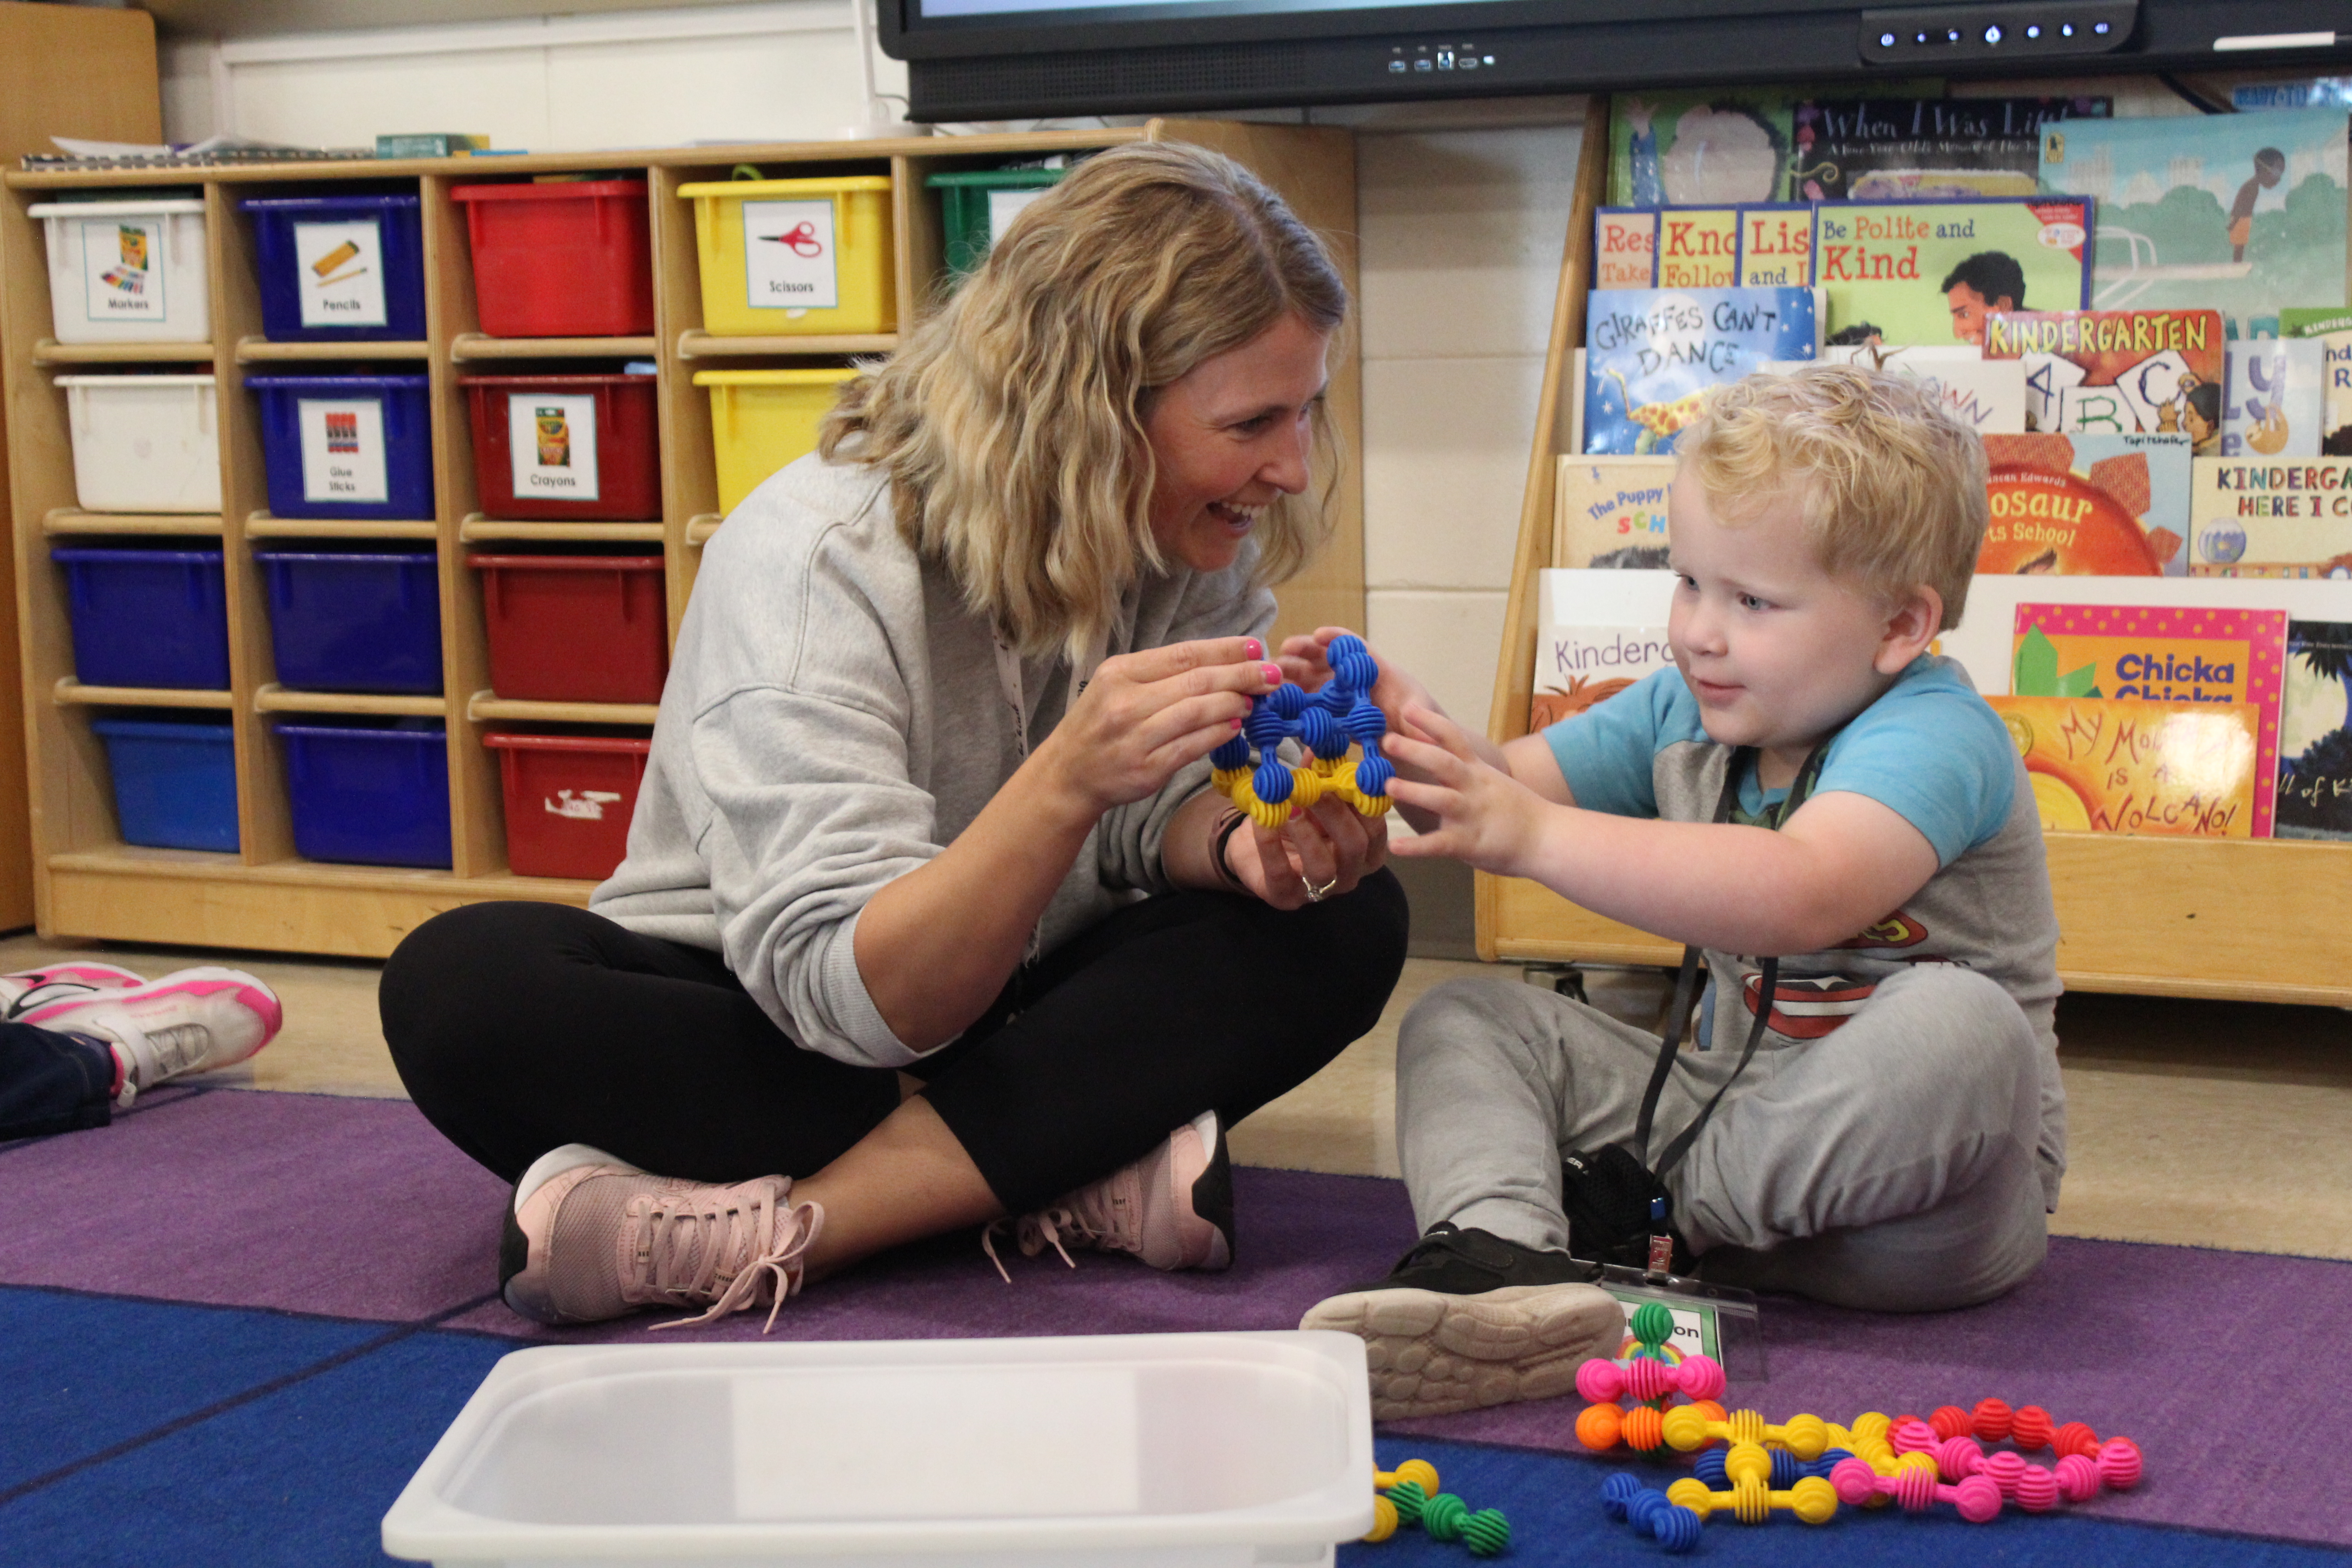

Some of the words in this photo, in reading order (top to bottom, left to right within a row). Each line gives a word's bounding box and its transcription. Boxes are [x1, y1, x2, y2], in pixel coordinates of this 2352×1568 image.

[1824, 102, 1896, 137] When
[1911, 101, 1922, 135] I
[1935, 106, 1987, 136] Was
[1750, 220, 1810, 255] Lis
[1823, 220, 1847, 240] Be
[1854, 215, 1930, 240] Polite
[1935, 218, 1975, 239] and
[1602, 263, 1650, 283] Take
[1821, 245, 1921, 281] Kind
[769, 280, 814, 293] Scissors
[1750, 266, 1788, 286] and
[108, 298, 149, 310] Markers
[323, 299, 361, 310] Pencils
[1595, 304, 1704, 350] GIRAFFES
[1712, 301, 1777, 332] CAN'T
[1989, 314, 2207, 354] KINDERGARTEN
[1637, 340, 1739, 377] DANCE
[329, 466, 353, 477] Glue
[530, 473, 576, 488] Crayons
[328, 481, 356, 491] Sticks
[1588, 500, 1616, 520] The
[1616, 488, 1664, 506] Puppy
[2238, 495, 2300, 517] HERE
[2310, 495, 2322, 517] I
[1617, 510, 1666, 534] SCH
[2013, 522, 2077, 547] School
[2115, 653, 2234, 684] Chicka
[2301, 776, 2326, 808] of
[2097, 791, 2238, 836] VOLCANO!
